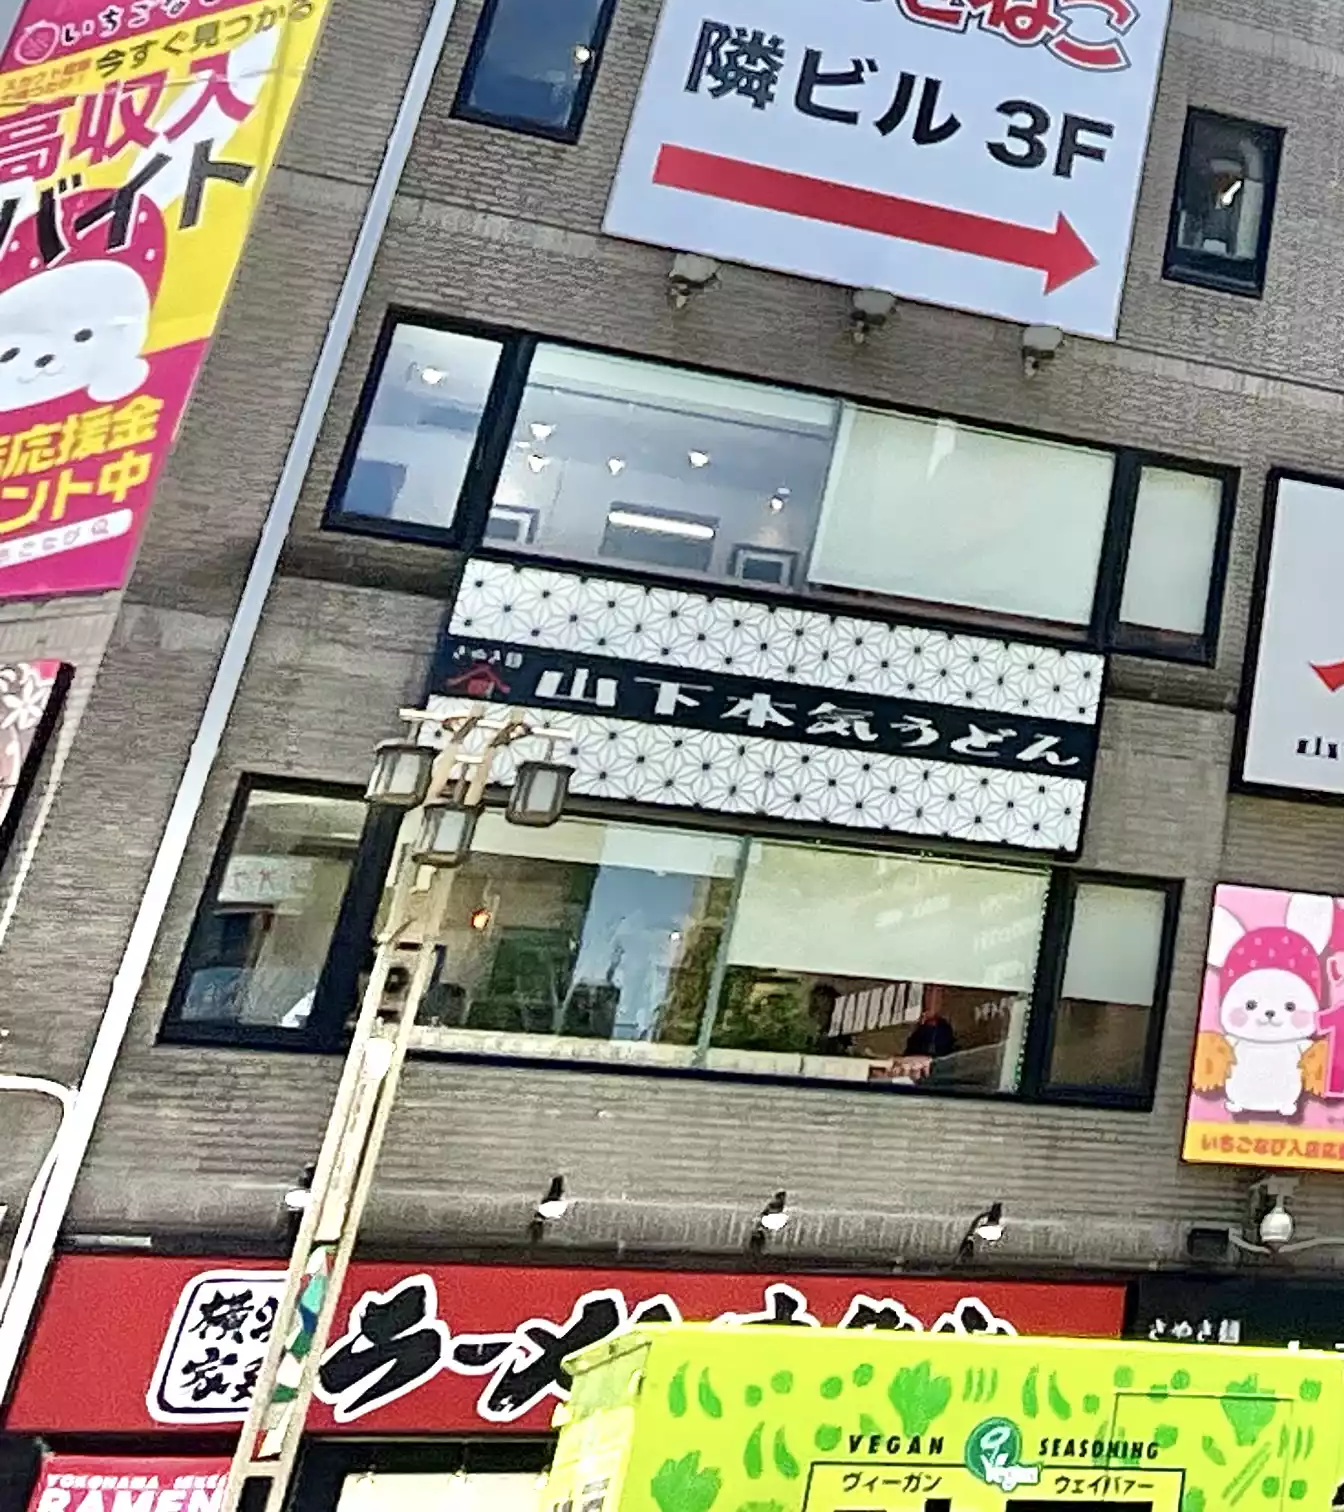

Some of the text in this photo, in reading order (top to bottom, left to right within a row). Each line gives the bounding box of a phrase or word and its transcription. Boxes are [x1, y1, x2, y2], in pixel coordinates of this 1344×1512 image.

[0, 50, 256, 185] 高収入
[683, 21, 1115, 179] 隣ビル 3F
[534, 666, 1082, 768] 山下本気うどん
[312, 1274, 682, 1422] ラーメ
[841, 1470, 943, 1494] ヴィーガン
[847, 1434, 1160, 1461] VEGAN SEASONING
